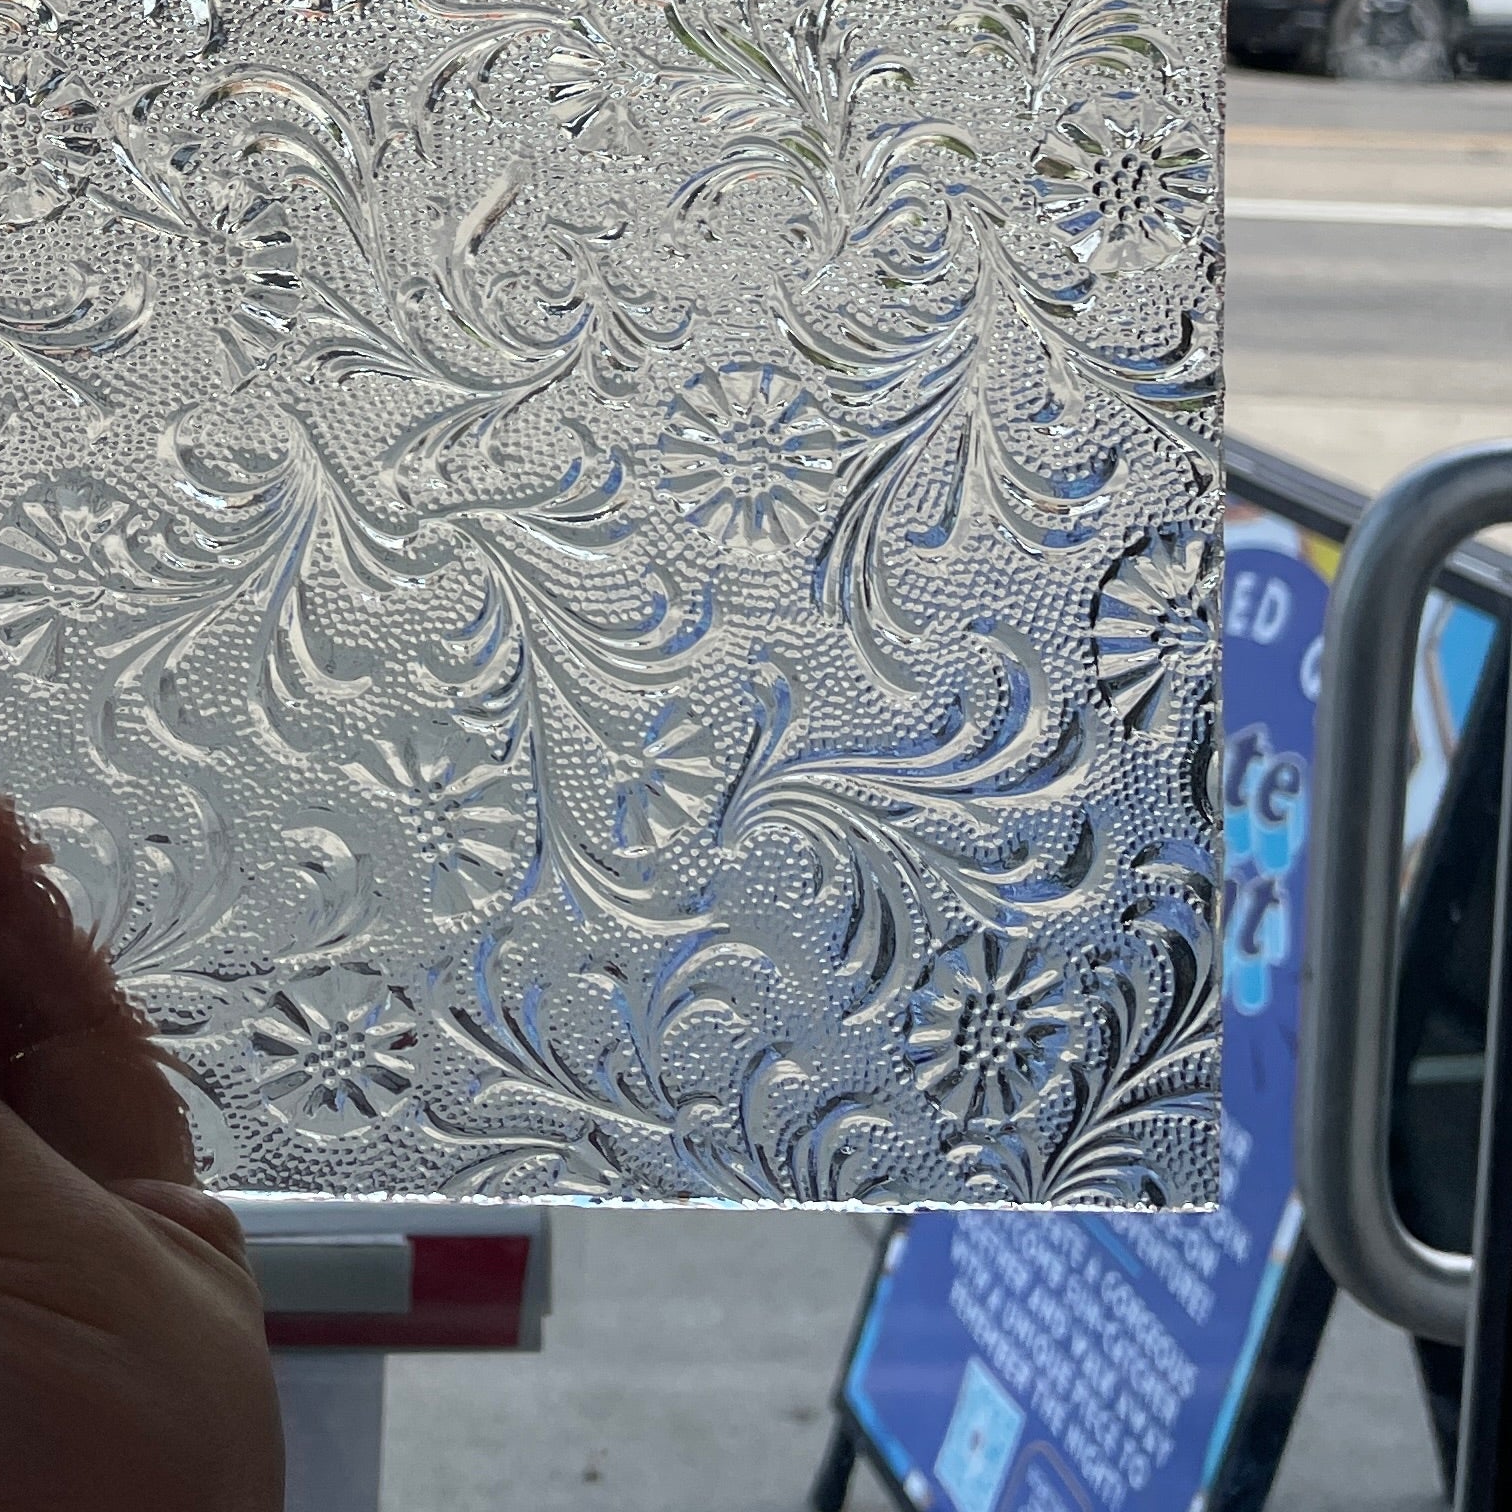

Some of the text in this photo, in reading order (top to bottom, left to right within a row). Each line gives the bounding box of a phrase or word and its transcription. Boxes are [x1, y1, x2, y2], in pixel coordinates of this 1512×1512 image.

[1030, 1375, 1069, 1437] THE
[1115, 1390, 1175, 1469] AWAY
[1119, 1435, 1150, 1491] TO
